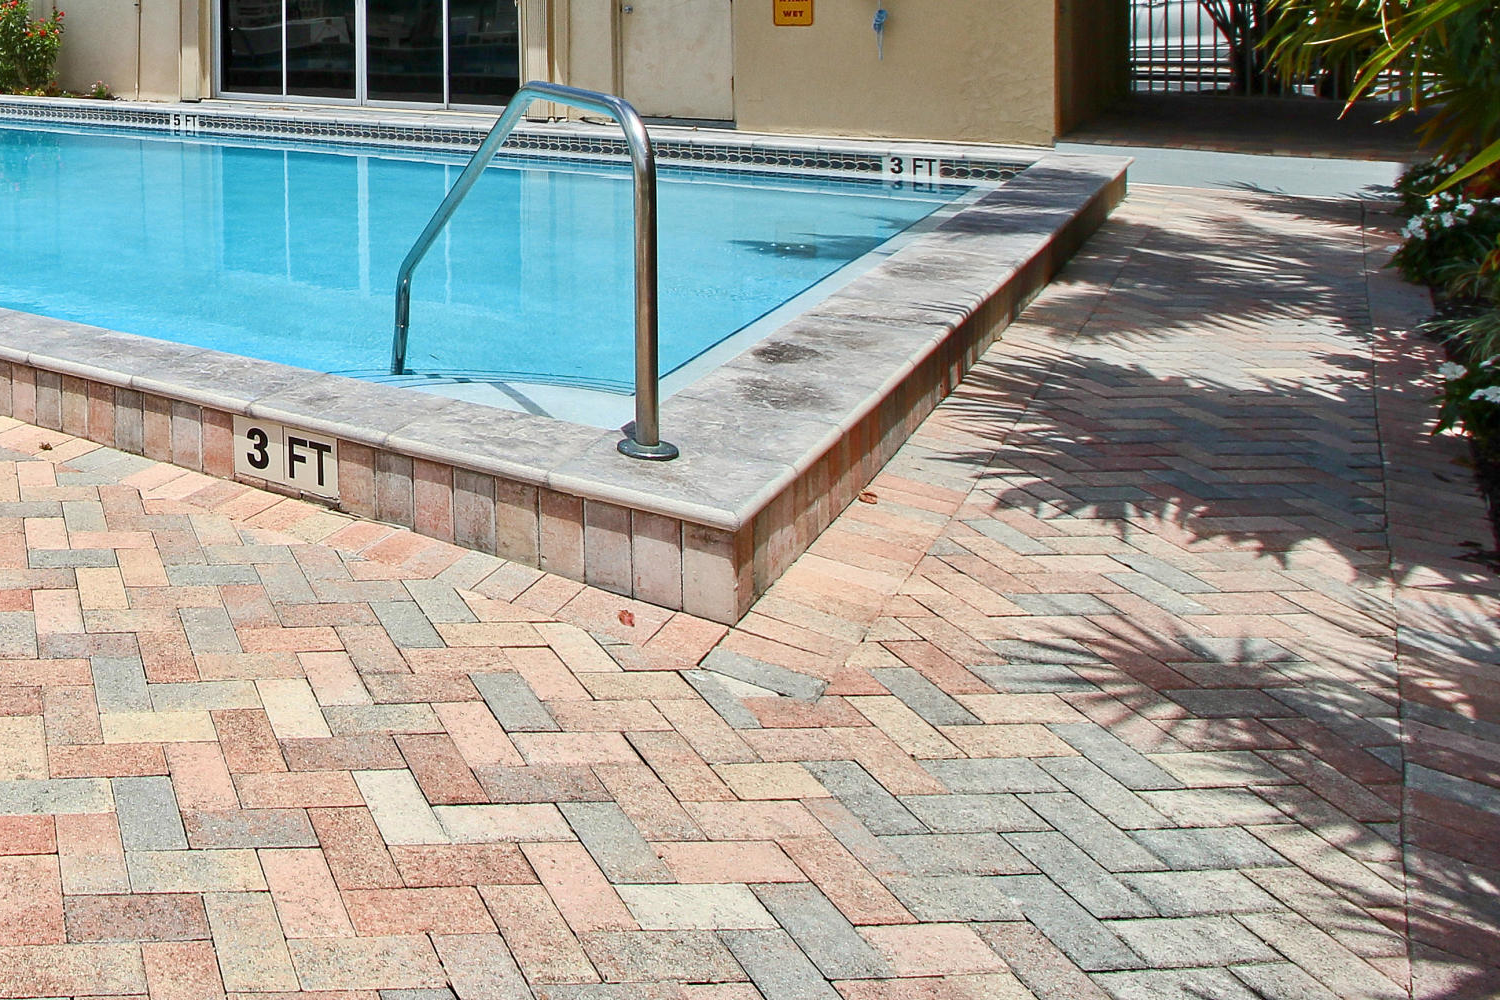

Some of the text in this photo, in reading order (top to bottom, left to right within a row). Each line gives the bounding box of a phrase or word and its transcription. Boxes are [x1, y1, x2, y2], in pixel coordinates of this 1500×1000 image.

[173, 114, 197, 128] 5 FT
[890, 157, 937, 177] 3 FT
[246, 427, 332, 486] 3 FT
